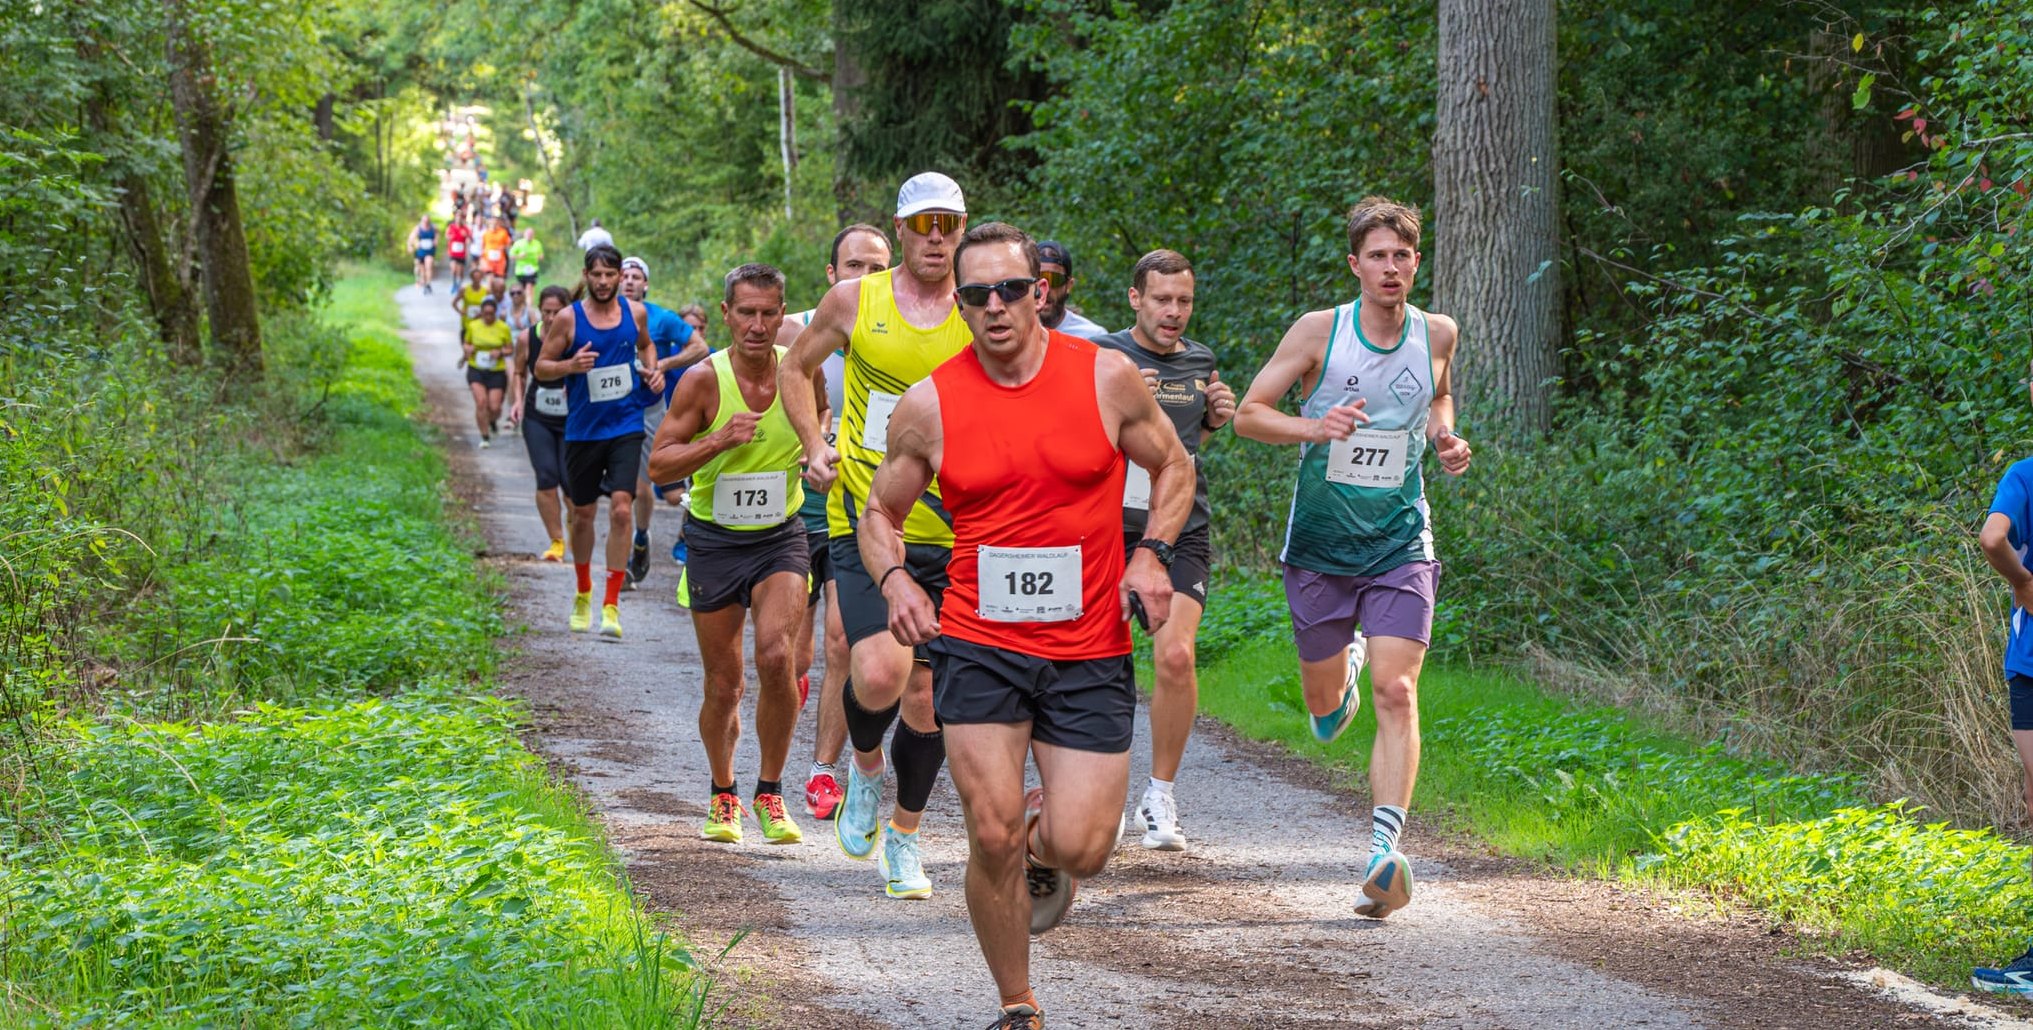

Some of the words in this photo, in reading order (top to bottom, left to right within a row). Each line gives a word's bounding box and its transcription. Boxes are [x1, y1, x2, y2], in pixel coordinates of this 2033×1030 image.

[601, 376, 621, 388] 276
[1351, 446, 1389, 467] 277
[733, 489, 768, 507] 173
[1005, 571, 1054, 596] 182
